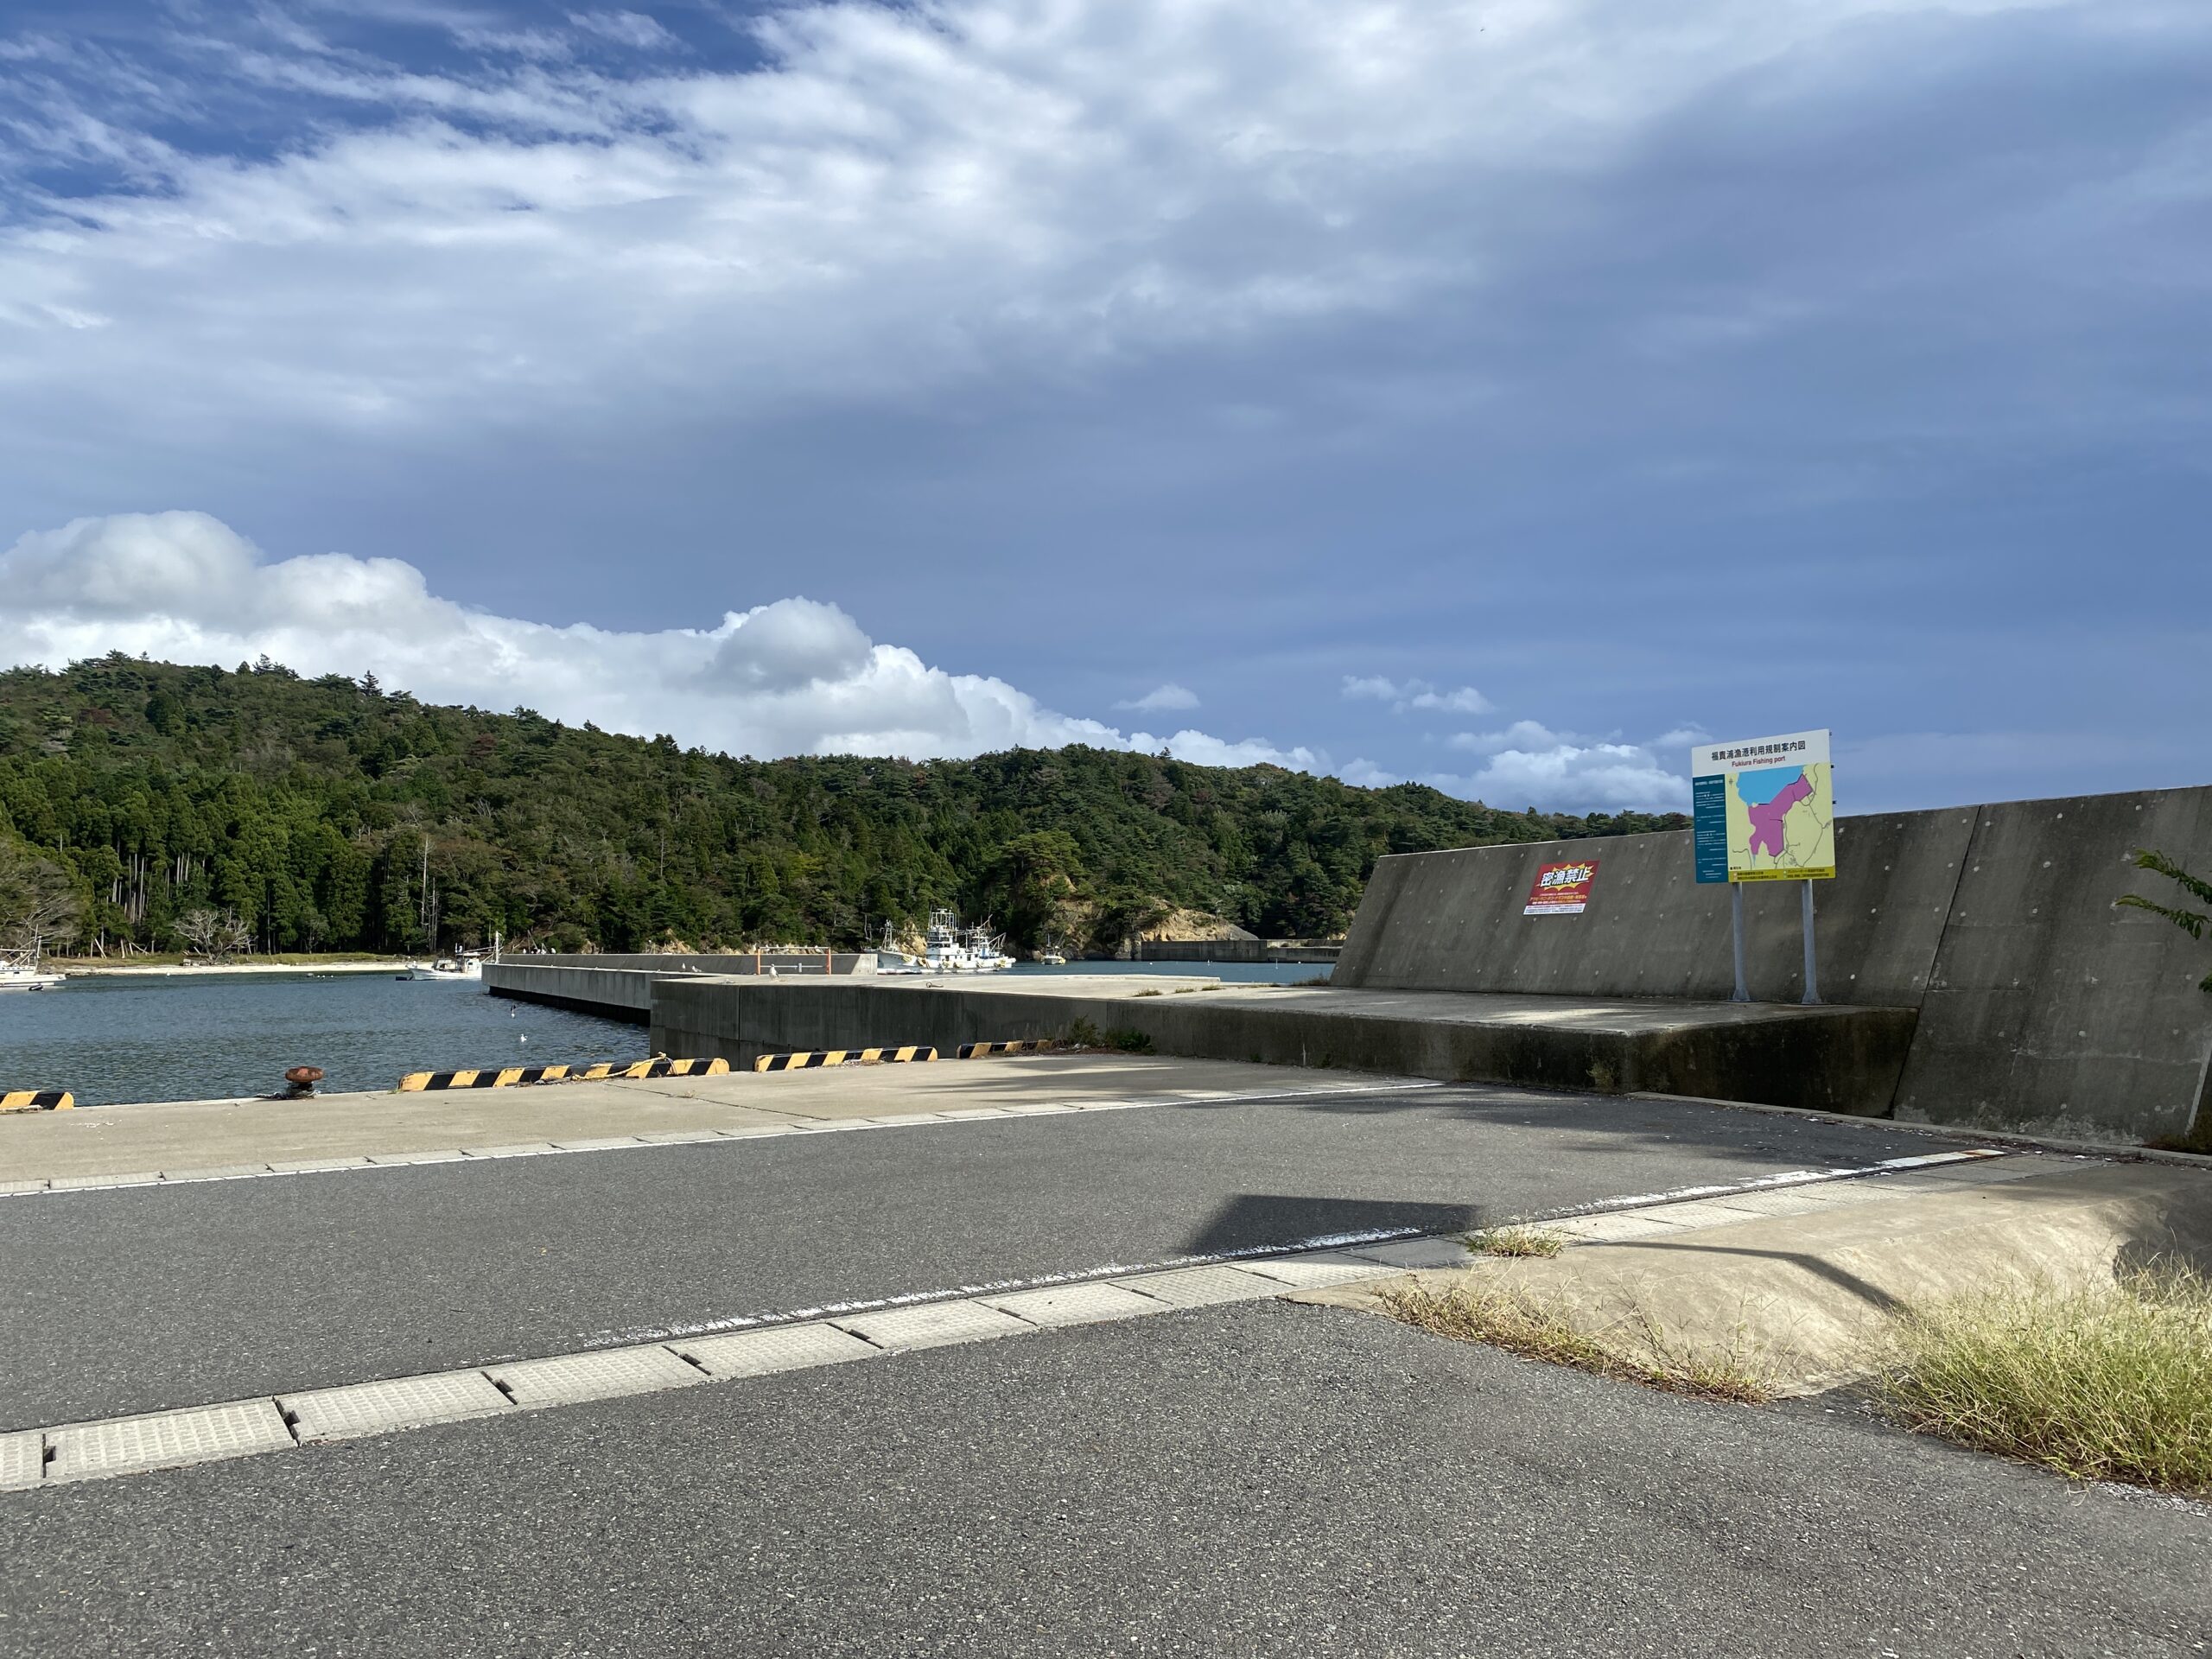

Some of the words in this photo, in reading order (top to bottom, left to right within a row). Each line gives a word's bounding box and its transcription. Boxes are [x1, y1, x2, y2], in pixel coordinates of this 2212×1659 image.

[1774, 755, 1786, 764] port
[1540, 866, 1591, 887] 密漁禁止
